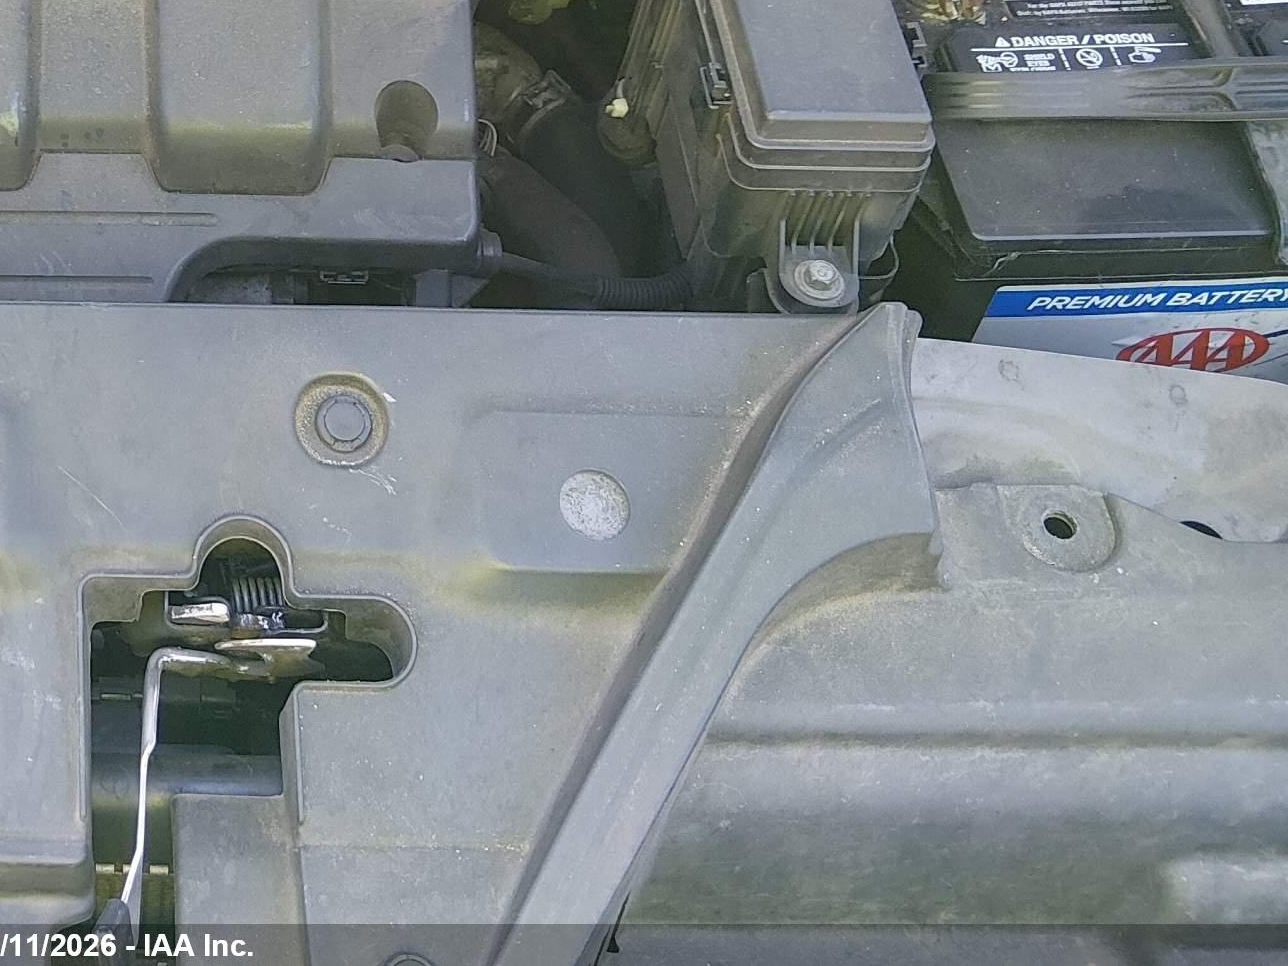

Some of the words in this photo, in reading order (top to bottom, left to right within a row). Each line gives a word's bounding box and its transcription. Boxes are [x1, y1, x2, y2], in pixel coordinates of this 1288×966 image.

[1011, 35, 1078, 47] DANGER
[1094, 32, 1155, 44] POISON
[1027, 292, 1168, 311] PREMIUM
[1135, 329, 1247, 371] AAA
